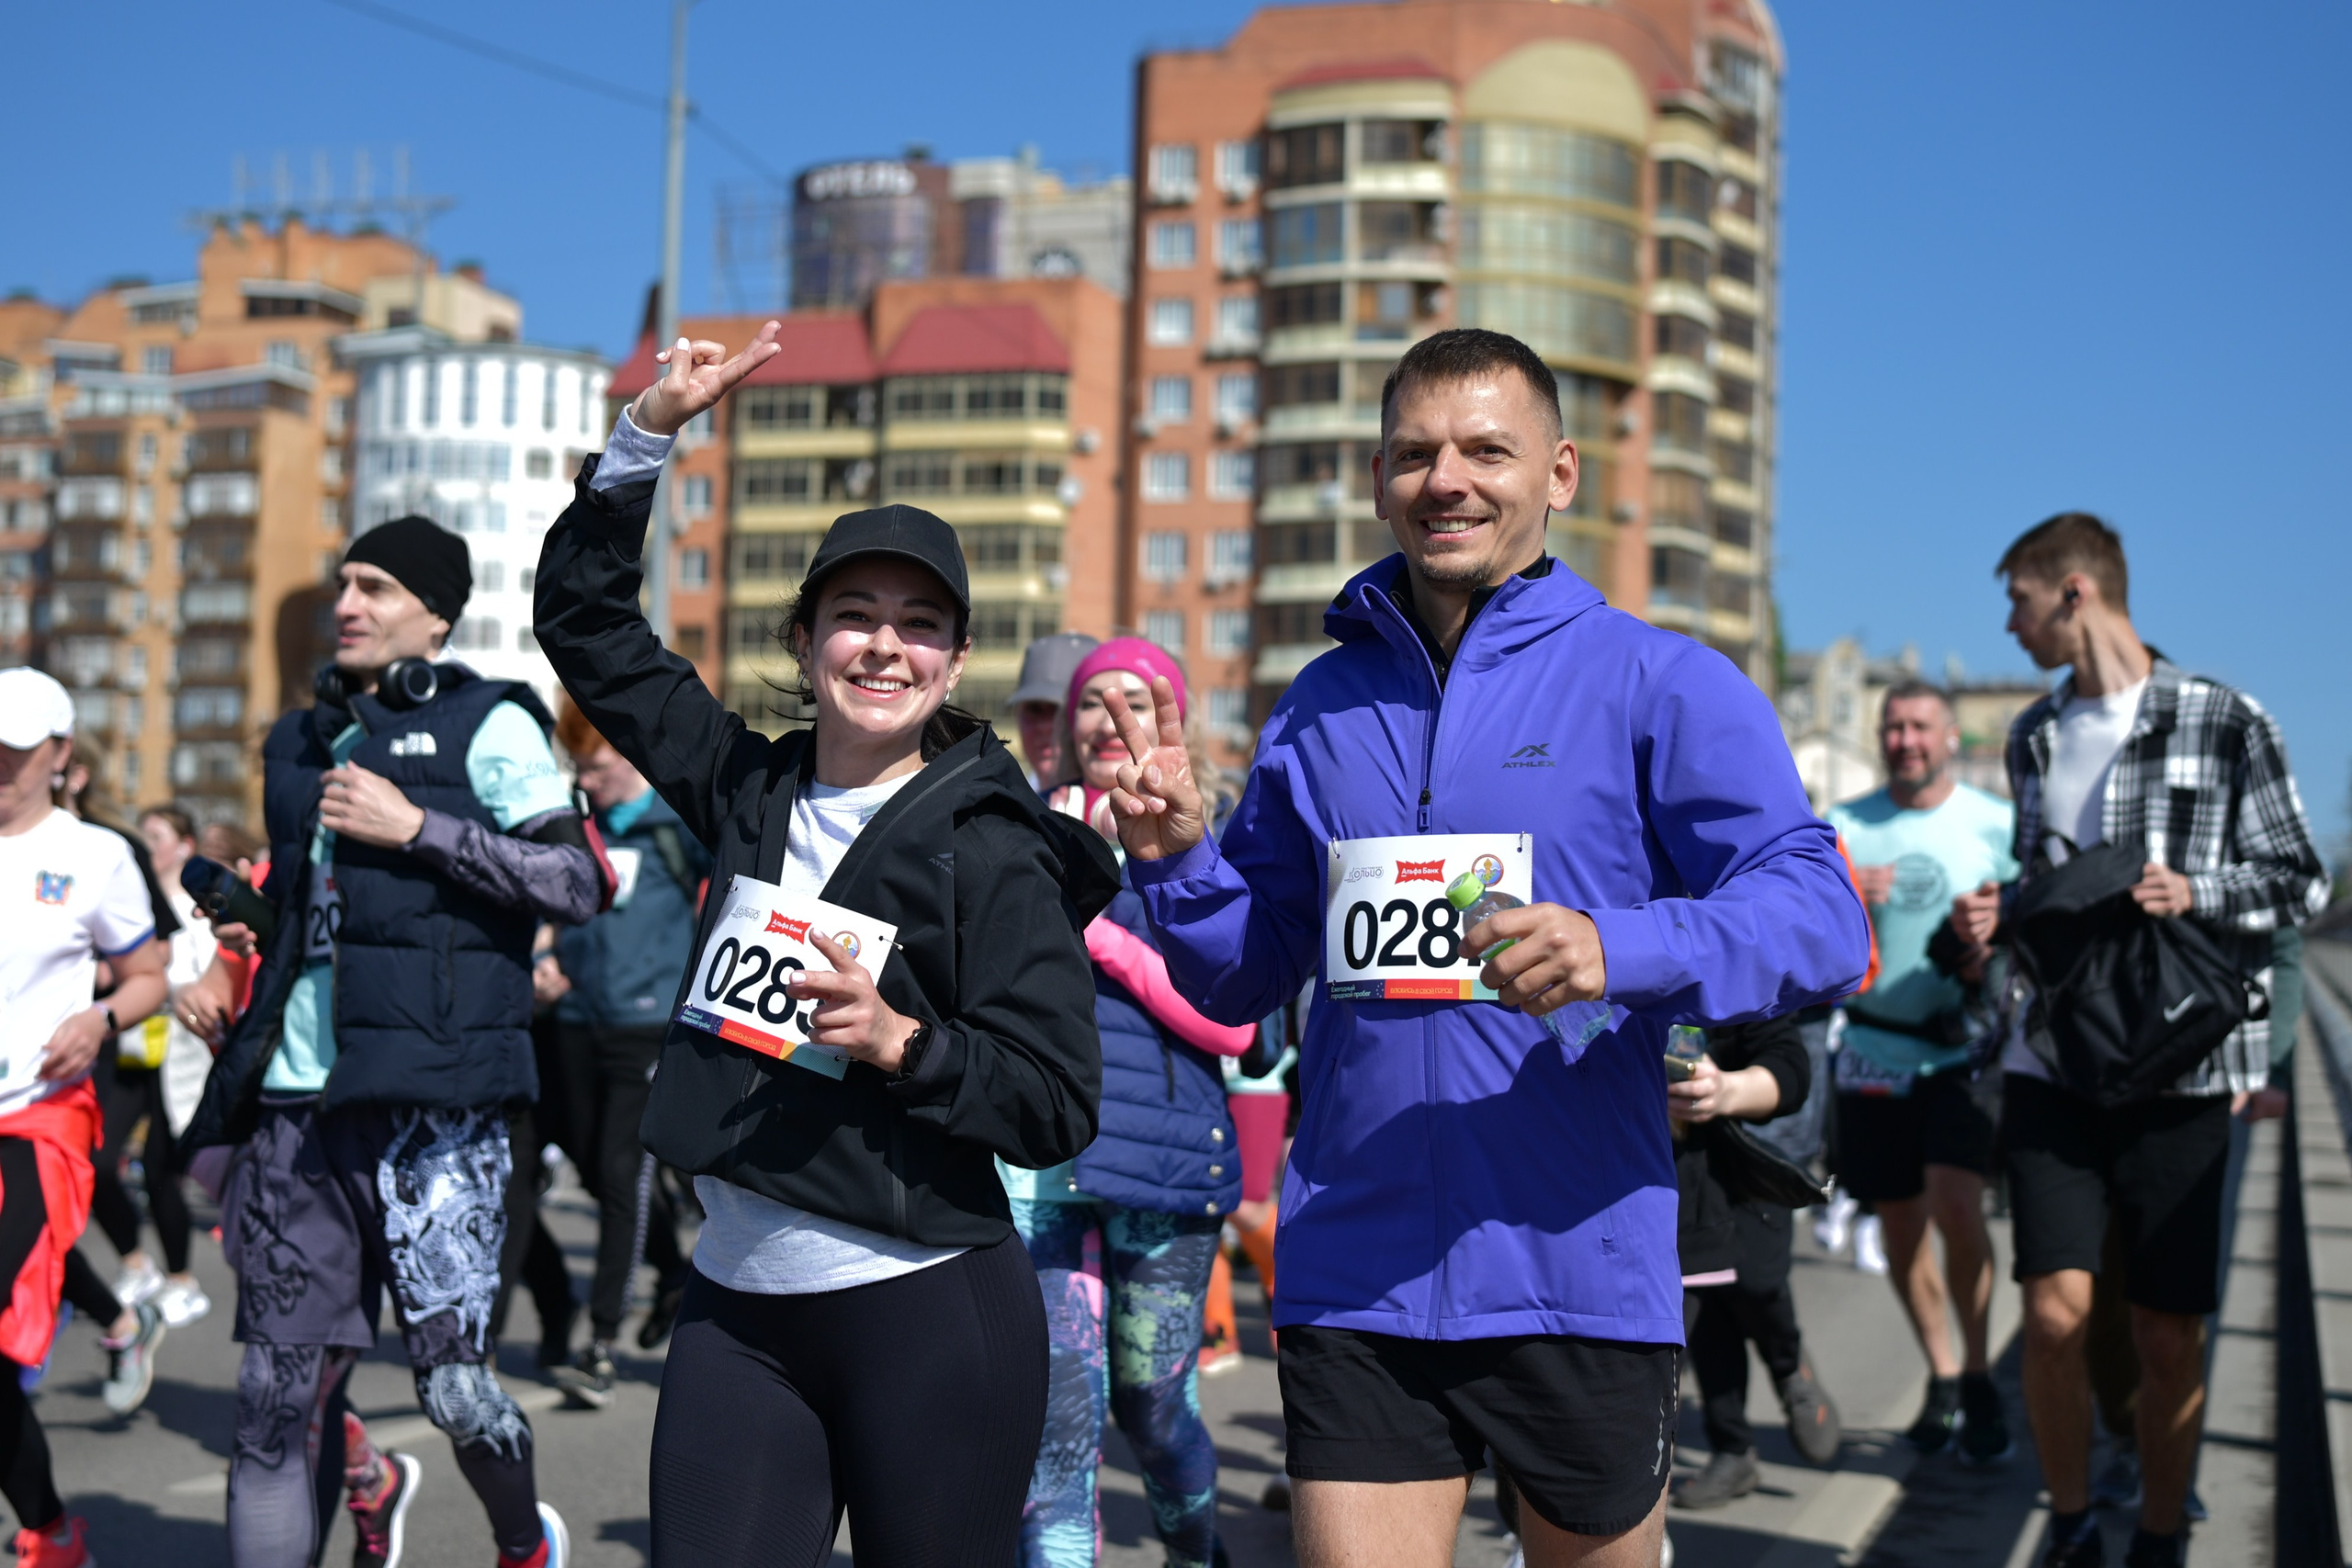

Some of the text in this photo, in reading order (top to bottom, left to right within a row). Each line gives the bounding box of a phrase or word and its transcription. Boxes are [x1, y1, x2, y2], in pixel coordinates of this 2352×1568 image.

[1501, 761, 1556, 769] ATHLEX
[1401, 868, 1421, 877] Альфа
[771, 919, 803, 934] Альфа Банк
[1344, 898, 1480, 970] 028
